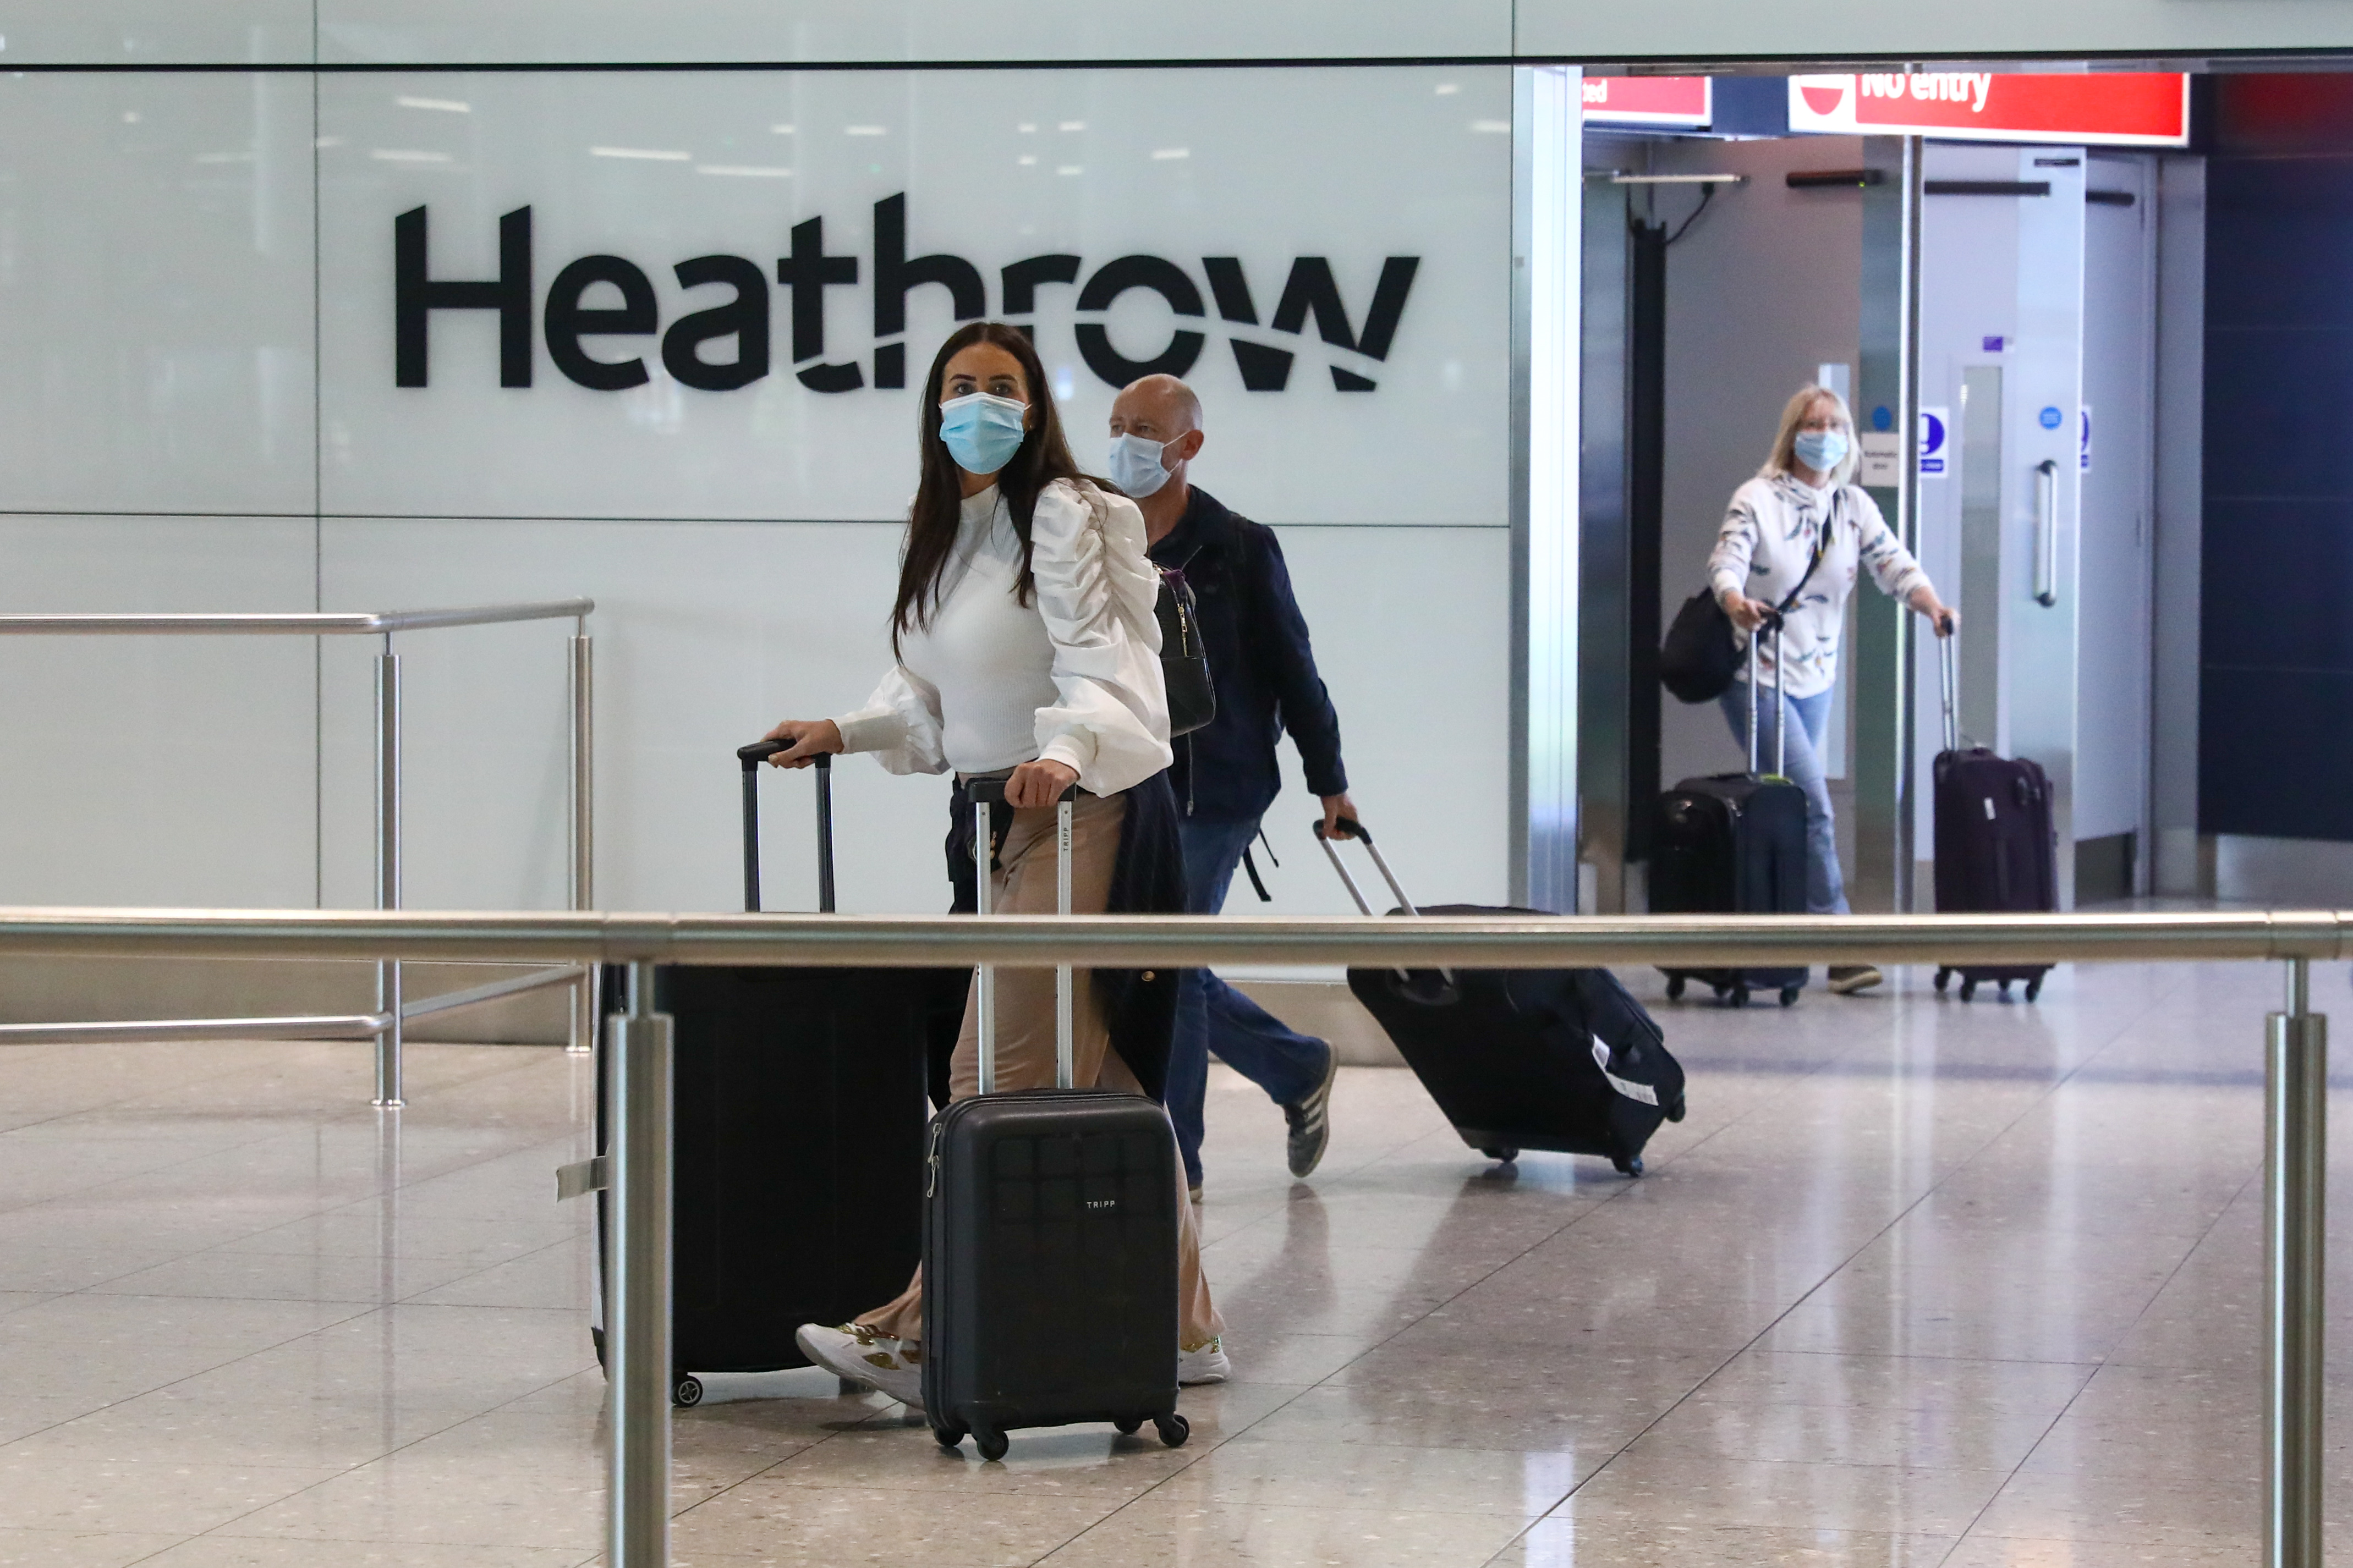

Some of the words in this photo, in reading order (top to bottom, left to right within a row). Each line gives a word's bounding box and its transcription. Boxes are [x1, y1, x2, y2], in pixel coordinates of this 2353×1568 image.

[1862, 73, 1905, 98] No
[1910, 73, 1992, 112] entry
[394, 192, 1420, 392] Heathrow
[1087, 1200, 1115, 1208] TRIPP
